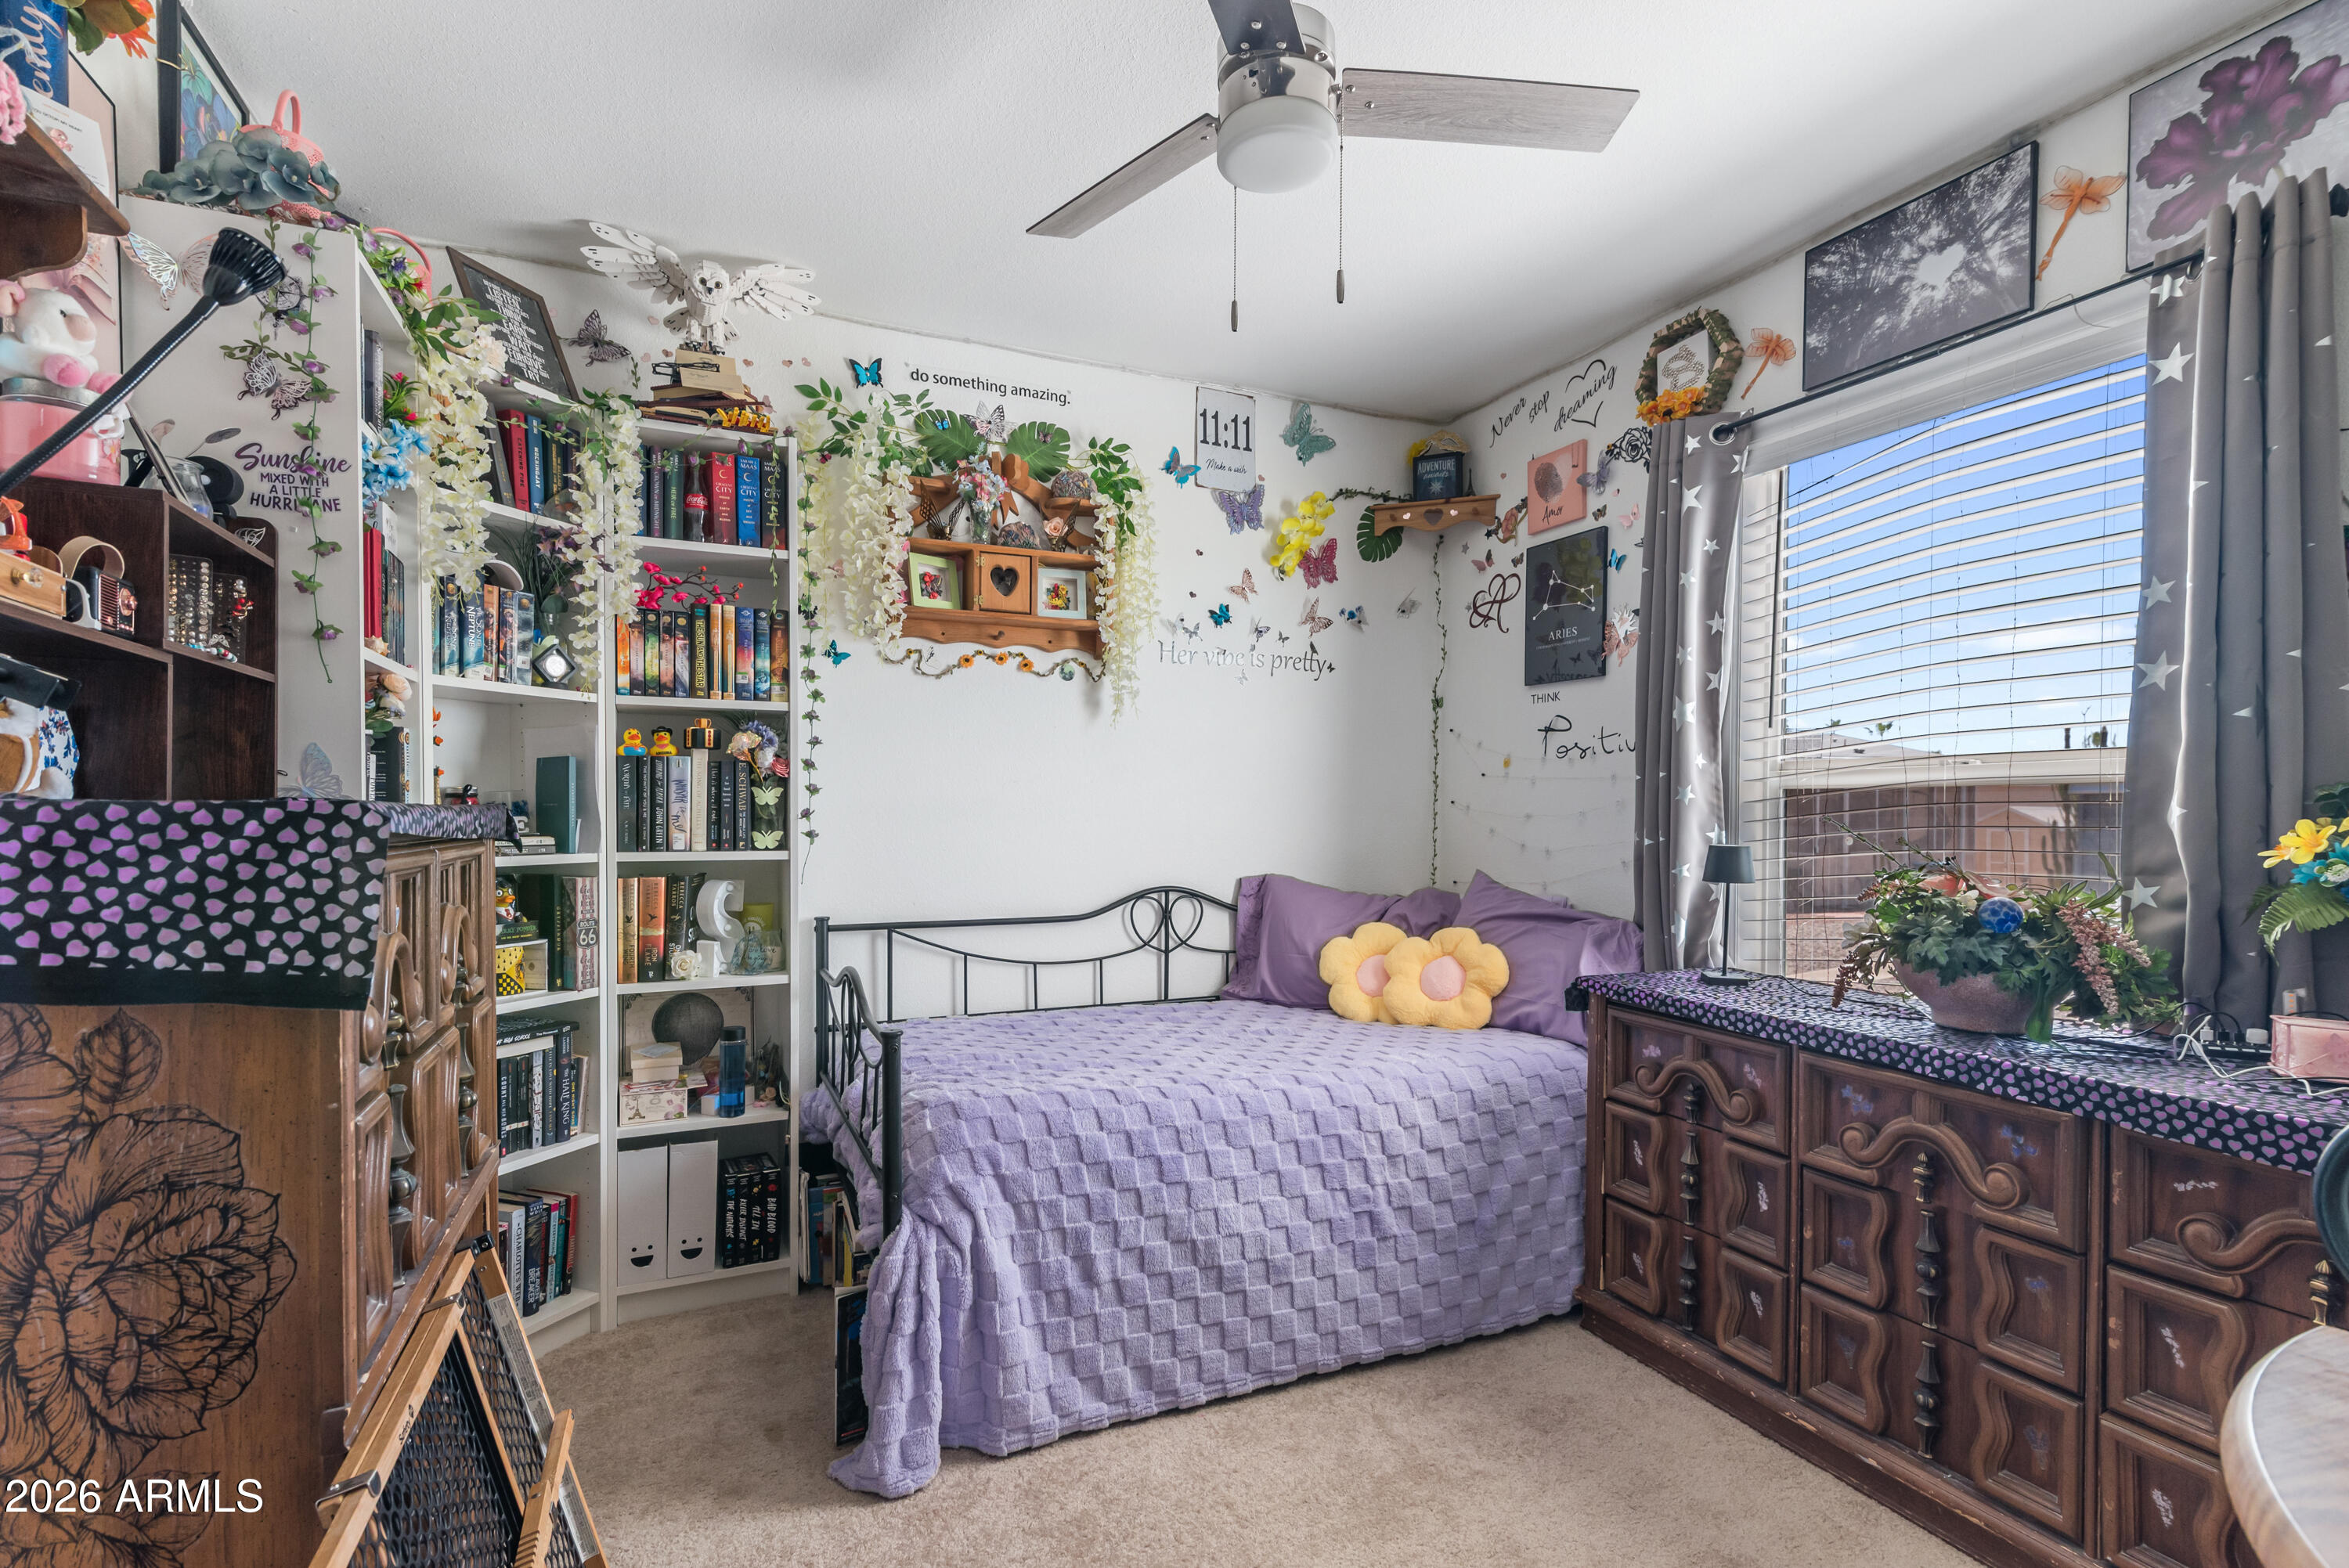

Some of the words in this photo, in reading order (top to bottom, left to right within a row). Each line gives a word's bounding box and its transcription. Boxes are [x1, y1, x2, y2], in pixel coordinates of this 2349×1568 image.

[911, 369, 929, 382] do
[933, 373, 1007, 396] something
[1011, 386, 1070, 406] amazing.
[1489, 397, 1527, 448] Never
[1529, 391, 1550, 424] stop
[1553, 365, 1618, 432] dreaming
[1200, 408, 1252, 452] 11:11
[235, 442, 351, 473] Sunshine
[1206, 458, 1225, 470] Make
[1234, 465, 1247, 474] wish
[1417, 459, 1456, 475] ADVENTURE
[1423, 471, 1449, 480] awaits
[260, 473, 294, 484] MIXED
[269, 485, 278, 494] A
[250, 492, 341, 512] HURRIANE
[1542, 505, 1563, 526] Amor
[466, 606, 474, 647] NEPTUNE
[695, 619, 705, 632] THE
[1548, 626, 1578, 641] ARIES
[695, 632, 705, 645] SUN
[695, 647, 705, 658] AND
[1157, 640, 1198, 665] Her
[1250, 651, 1265, 668] is
[1271, 650, 1326, 681] pretty
[695, 659, 705, 671] THE
[695, 672, 705, 688] STAR
[1531, 690, 1560, 704] THINK
[1538, 715, 1636, 759] Positiv
[671, 780, 688, 804] WHISPER
[655, 806, 664, 824] JOHN
[671, 812, 687, 833] me
[655, 825, 664, 844] GREEN
[579, 928, 597, 946] 66
[561, 1078, 569, 1102] HALF
[561, 1103, 570, 1125] KING
[767, 1198, 777, 1211] BAD
[752, 1220, 760, 1231] IN
[767, 1213, 777, 1234] BLOOD
